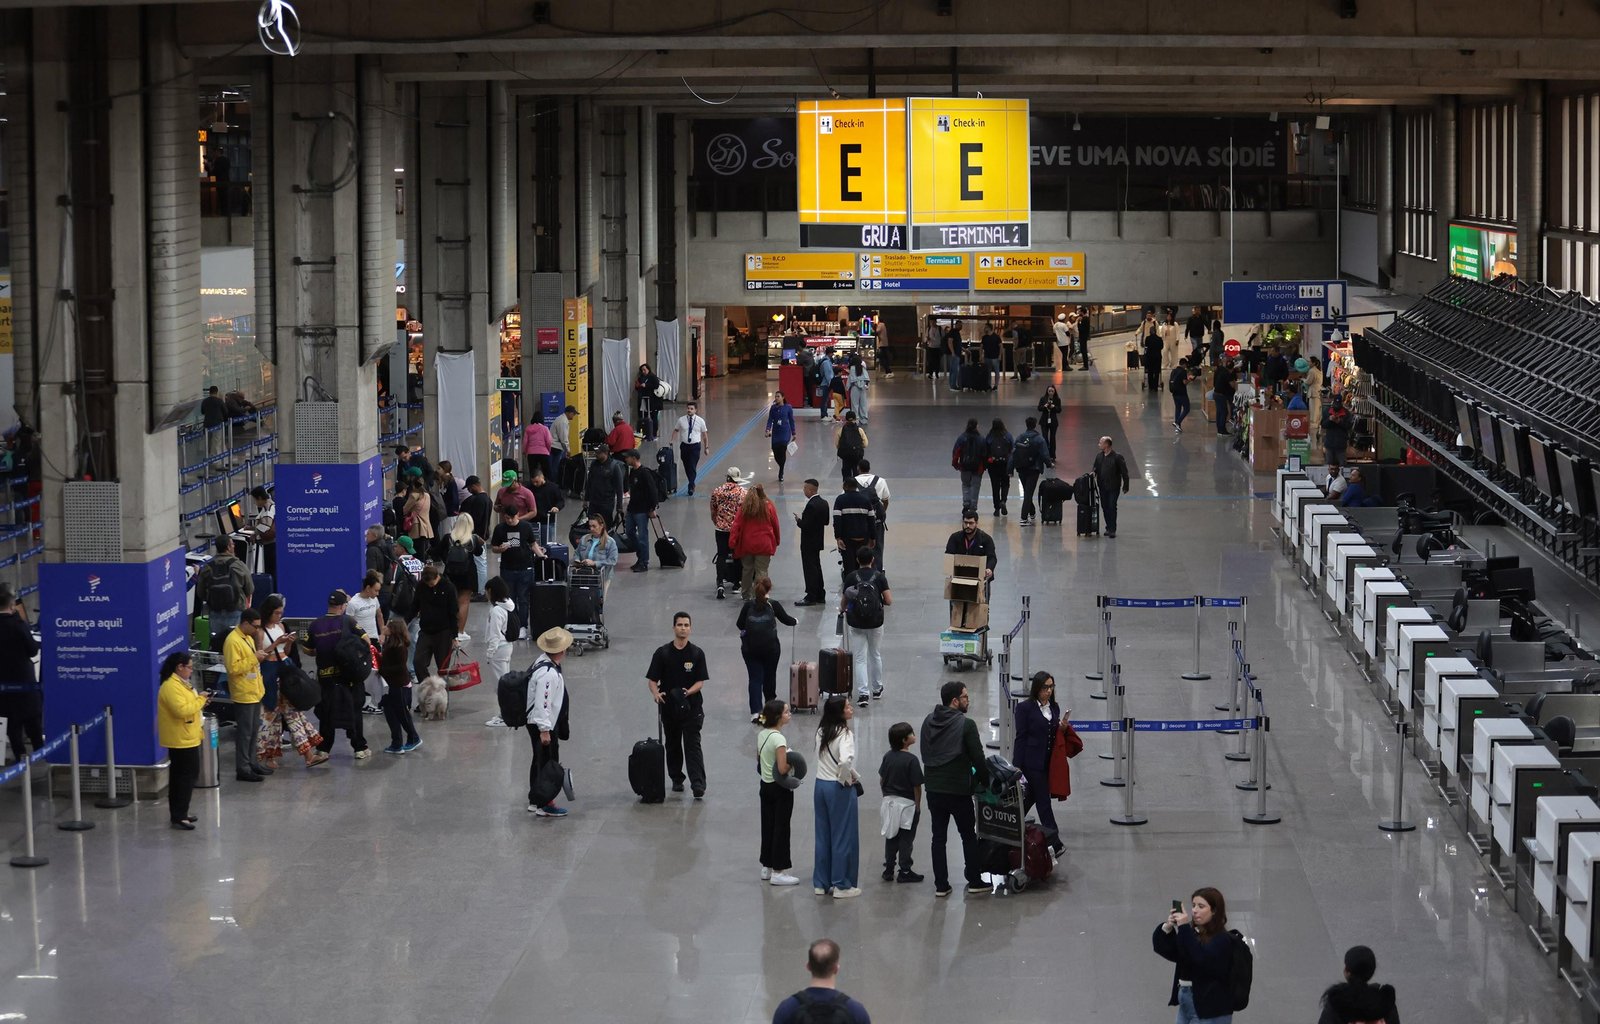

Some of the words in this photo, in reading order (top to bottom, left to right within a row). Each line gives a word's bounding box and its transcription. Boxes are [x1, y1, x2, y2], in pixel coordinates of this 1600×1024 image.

[834, 119, 865, 128] Check-in
[953, 118, 986, 127] Check-in
[752, 138, 798, 169] So
[1077, 145, 1129, 166] UMA
[1135, 145, 1202, 166] NOVA
[1207, 140, 1276, 167] SODIÊ
[840, 143, 862, 202] E
[960, 142, 983, 201] E
[861, 225, 888, 247] GRU
[890, 226, 901, 247] A
[940, 226, 1009, 245] TERMINAL
[1006, 257, 1044, 266] Check-in
[987, 276, 1022, 285] Elevador
[1028, 276, 1055, 285] Elevator
[1257, 283, 1296, 291] Sanitários
[568, 310, 575, 320] 2
[568, 329, 575, 341] E
[567, 348, 576, 392] Check-in
[286, 505, 318, 515] Começa
[319, 505, 339, 515] aqui!
[55, 618, 96, 630] Começa
[97, 618, 123, 630] aqui!
[92, 666, 118, 674] Bagagem
[994, 810, 1017, 823] TOTVS
